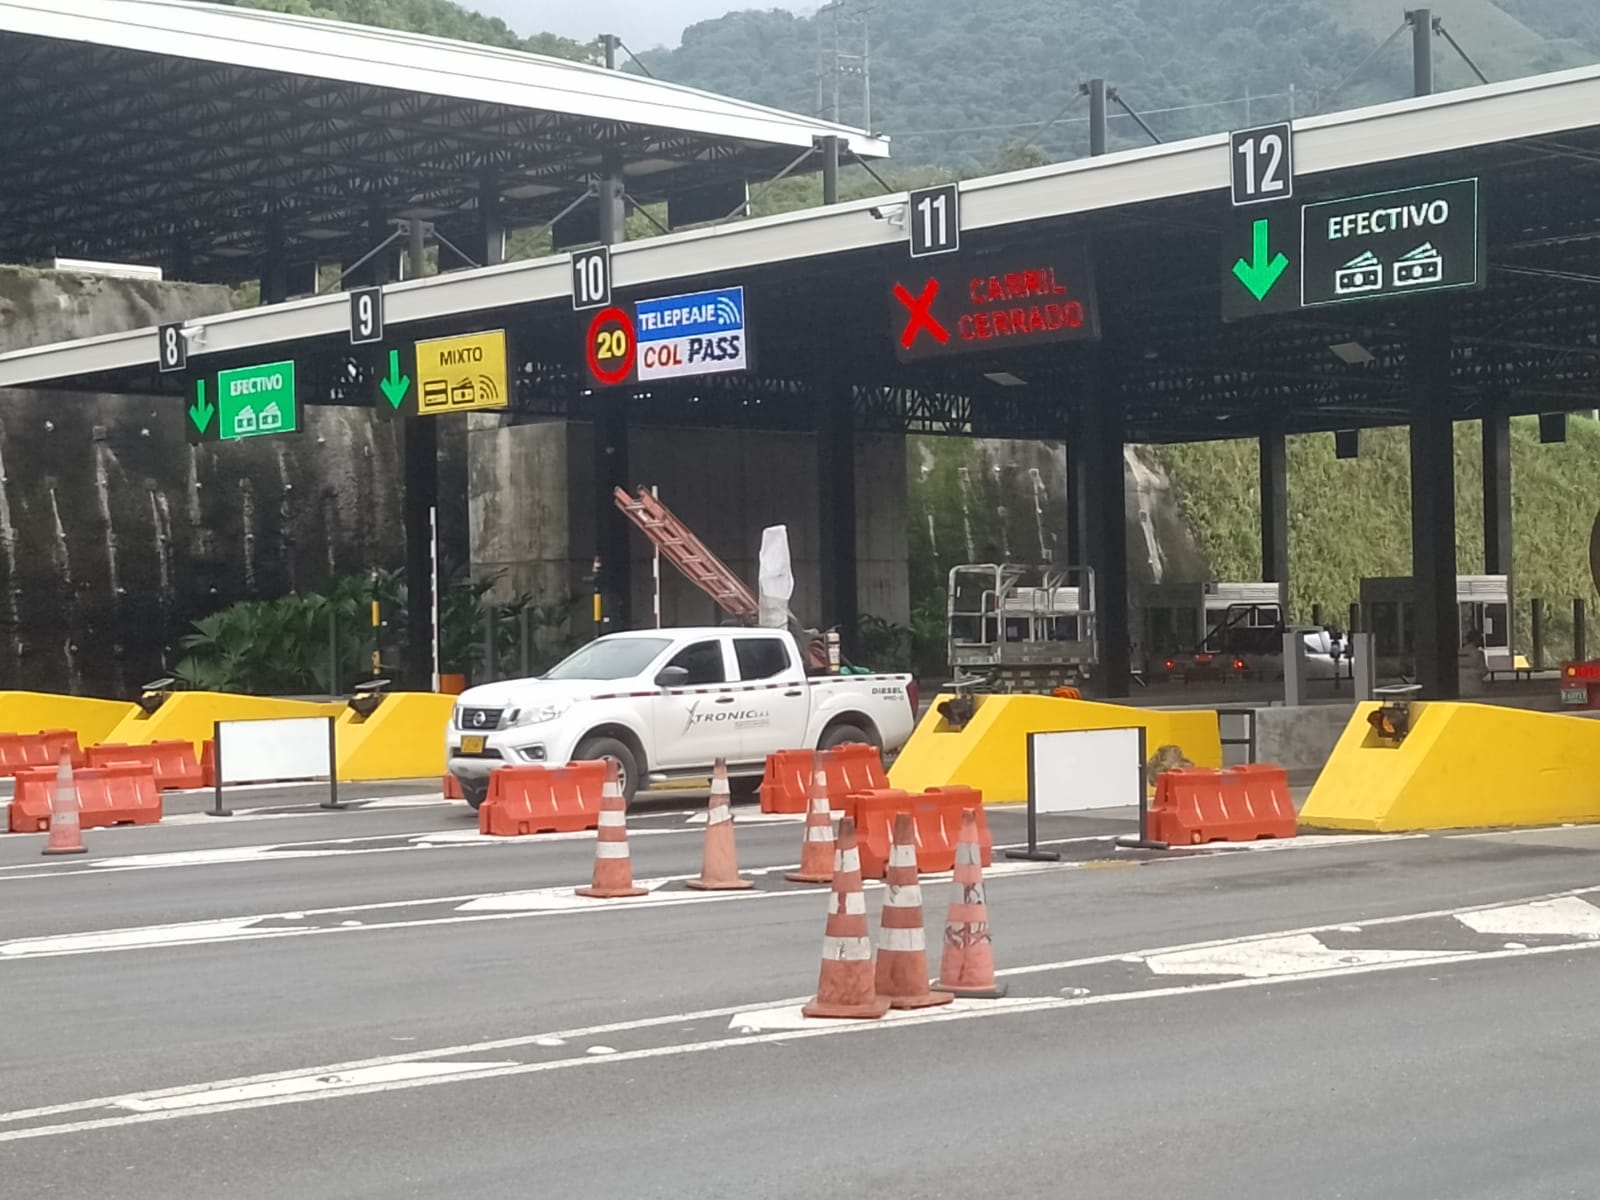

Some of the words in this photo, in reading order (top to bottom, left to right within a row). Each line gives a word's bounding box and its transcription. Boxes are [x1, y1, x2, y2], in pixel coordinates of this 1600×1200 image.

[1238, 133, 1284, 194] 12
[917, 194, 947, 248] 11
[1328, 200, 1449, 240] EFECTIVO
[575, 255, 604, 302] 10
[968, 267, 1067, 304] CARRIL
[358, 294, 373, 336] 9
[638, 303, 716, 331] TELEPEAJE
[958, 301, 1084, 340] CERRADO
[165, 327, 178, 366] 8
[439, 346, 483, 367] MIXTO
[596, 330, 626, 360] 20
[643, 344, 682, 369] COL
[688, 335, 740, 363] PASS
[230, 373, 282, 397] EFECTIVO
